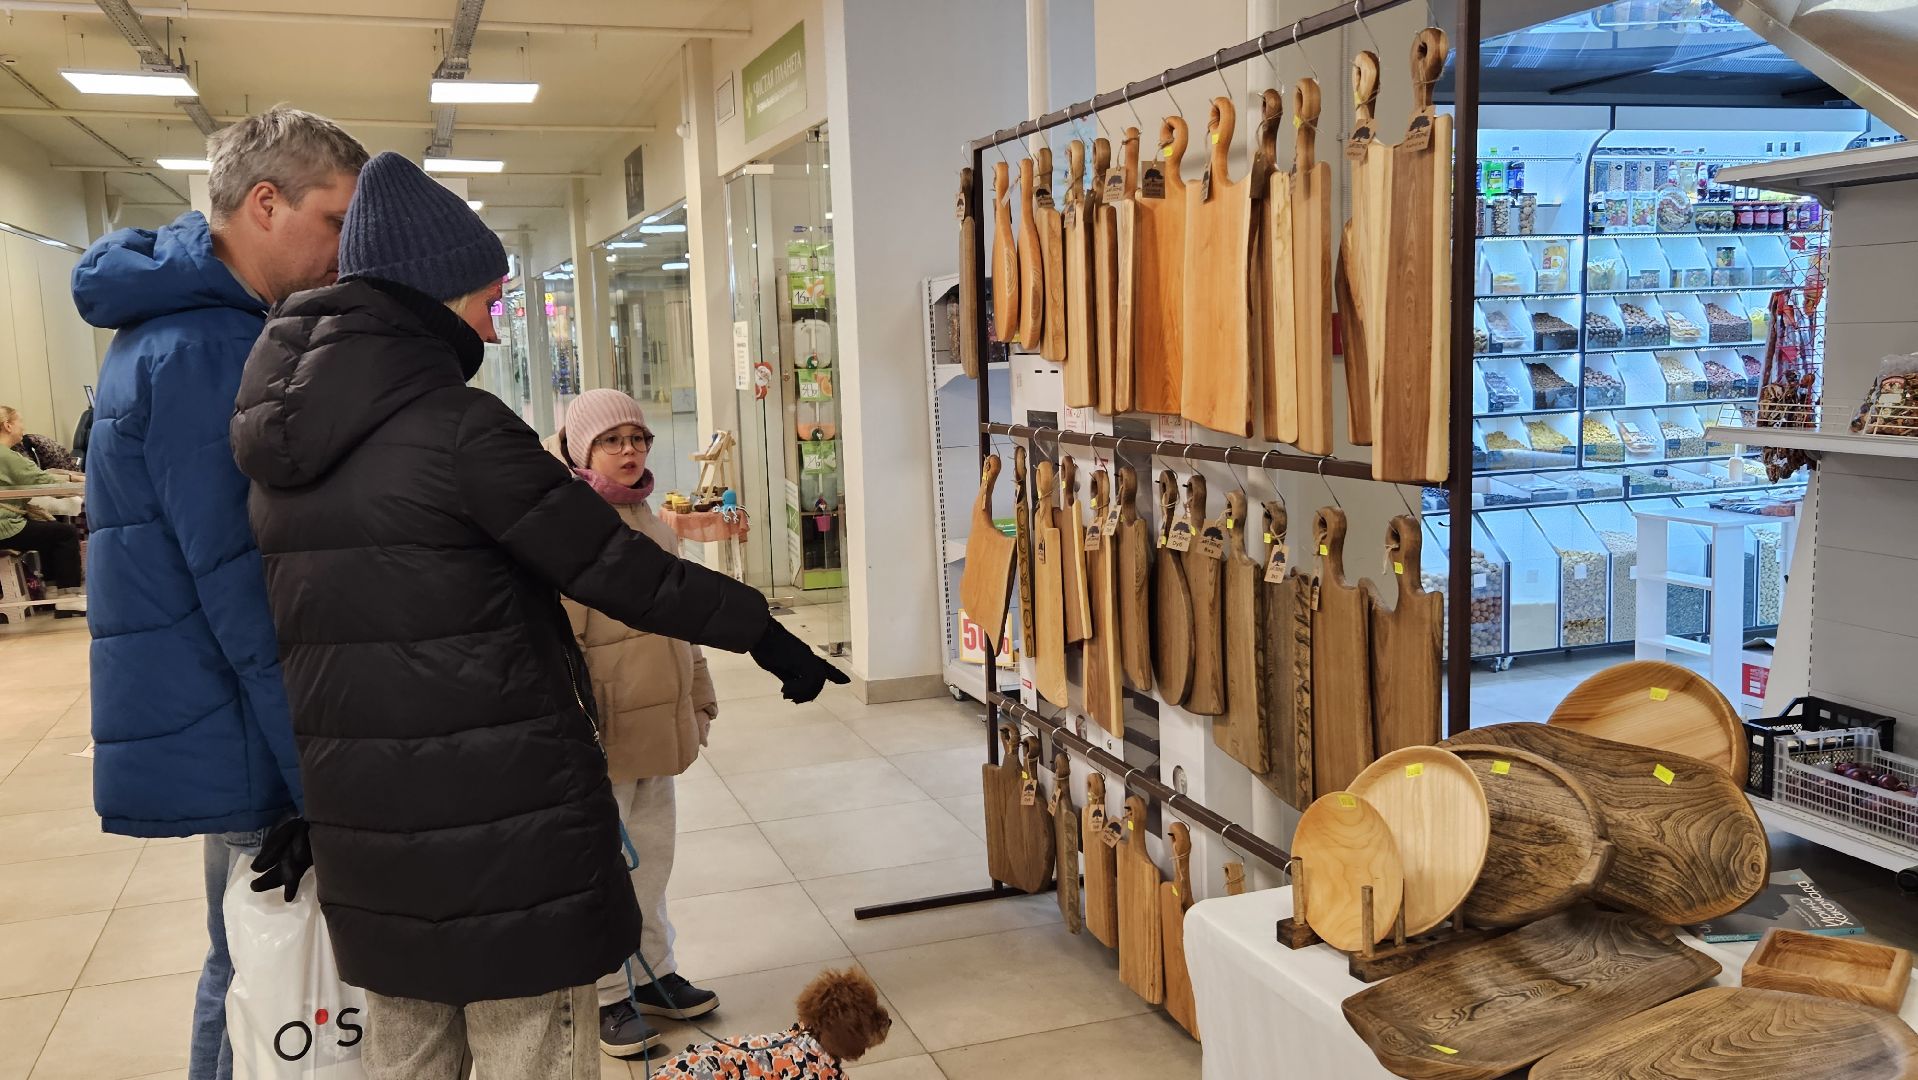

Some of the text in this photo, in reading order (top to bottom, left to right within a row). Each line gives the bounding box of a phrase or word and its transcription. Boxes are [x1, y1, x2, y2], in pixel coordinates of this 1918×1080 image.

[753, 69, 774, 98] ЧИСТАЯ
[774, 49, 802, 84] ПЛАНЕТА
[963, 619, 1010, 655] 50
[1800, 898, 1839, 927] Ирина
